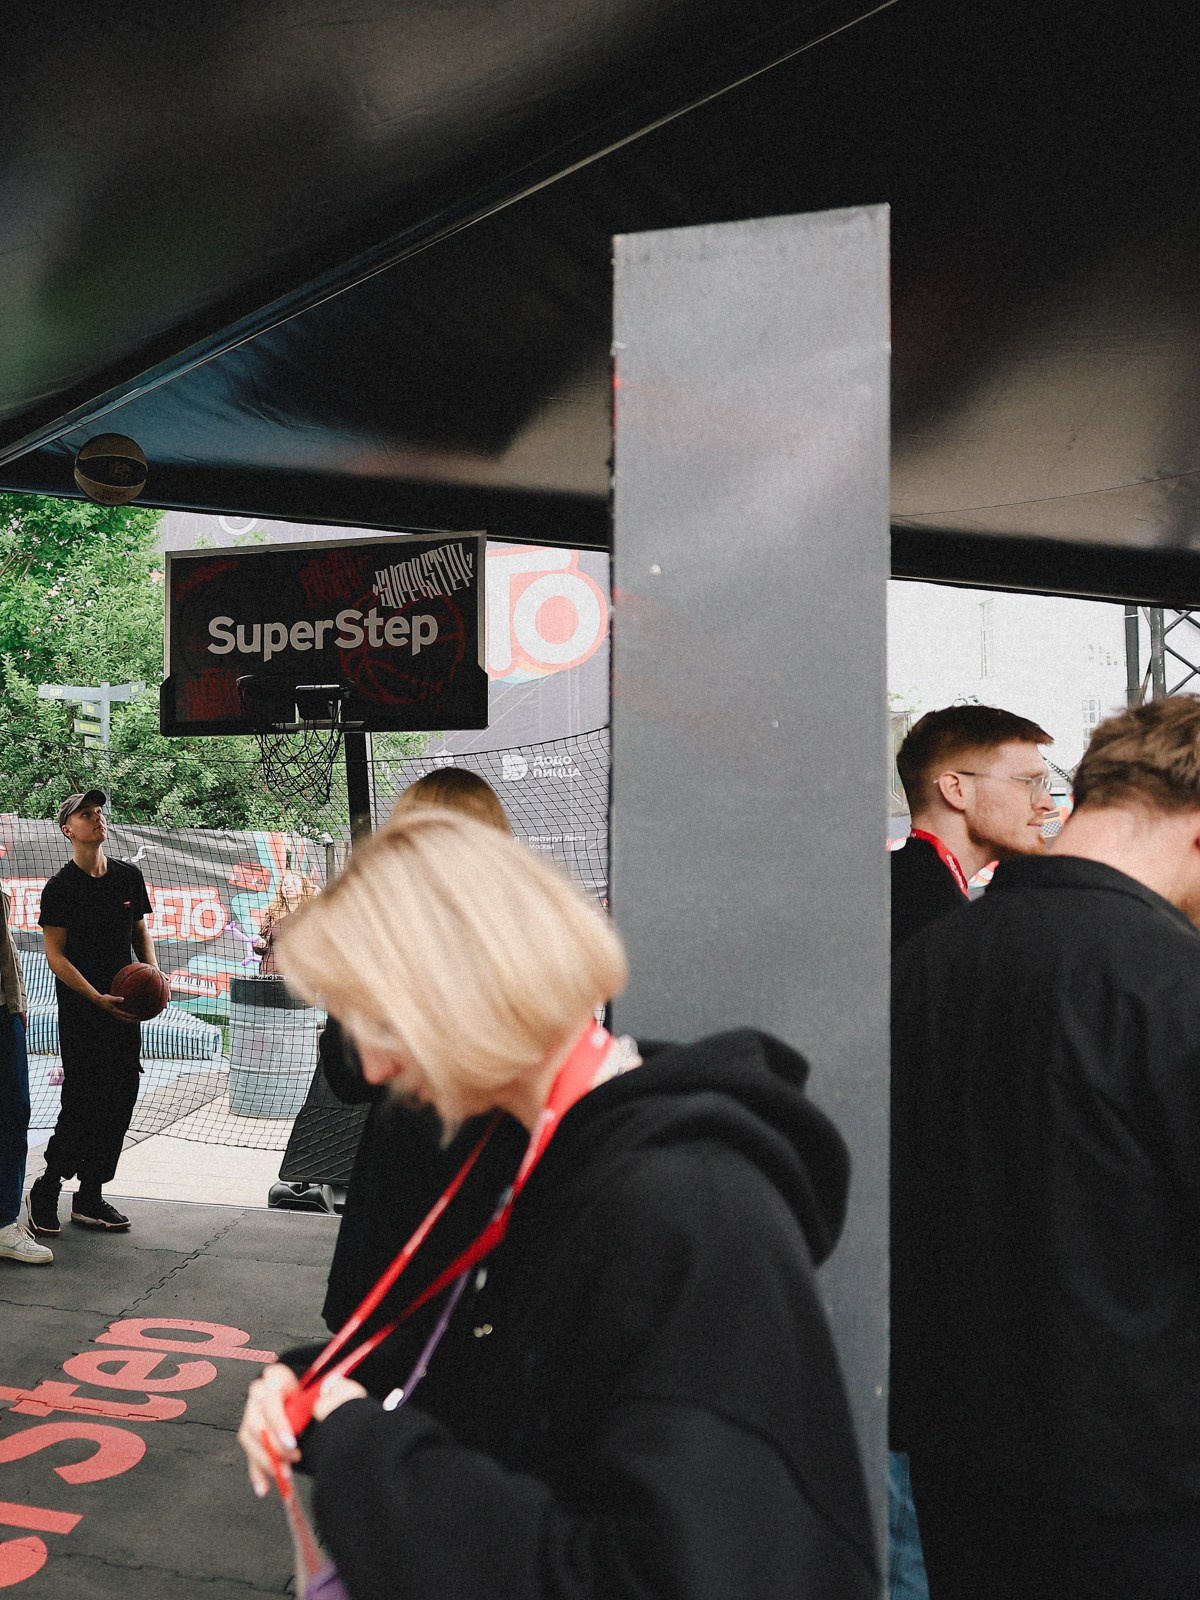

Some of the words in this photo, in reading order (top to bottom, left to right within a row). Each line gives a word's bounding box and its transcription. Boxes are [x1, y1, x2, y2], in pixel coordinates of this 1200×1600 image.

[207, 607, 439, 663] SuperStep
[533, 755, 572, 767] ДОДО
[533, 767, 582, 779] ПИЦЦА
[144, 884, 227, 938] ЕТО
